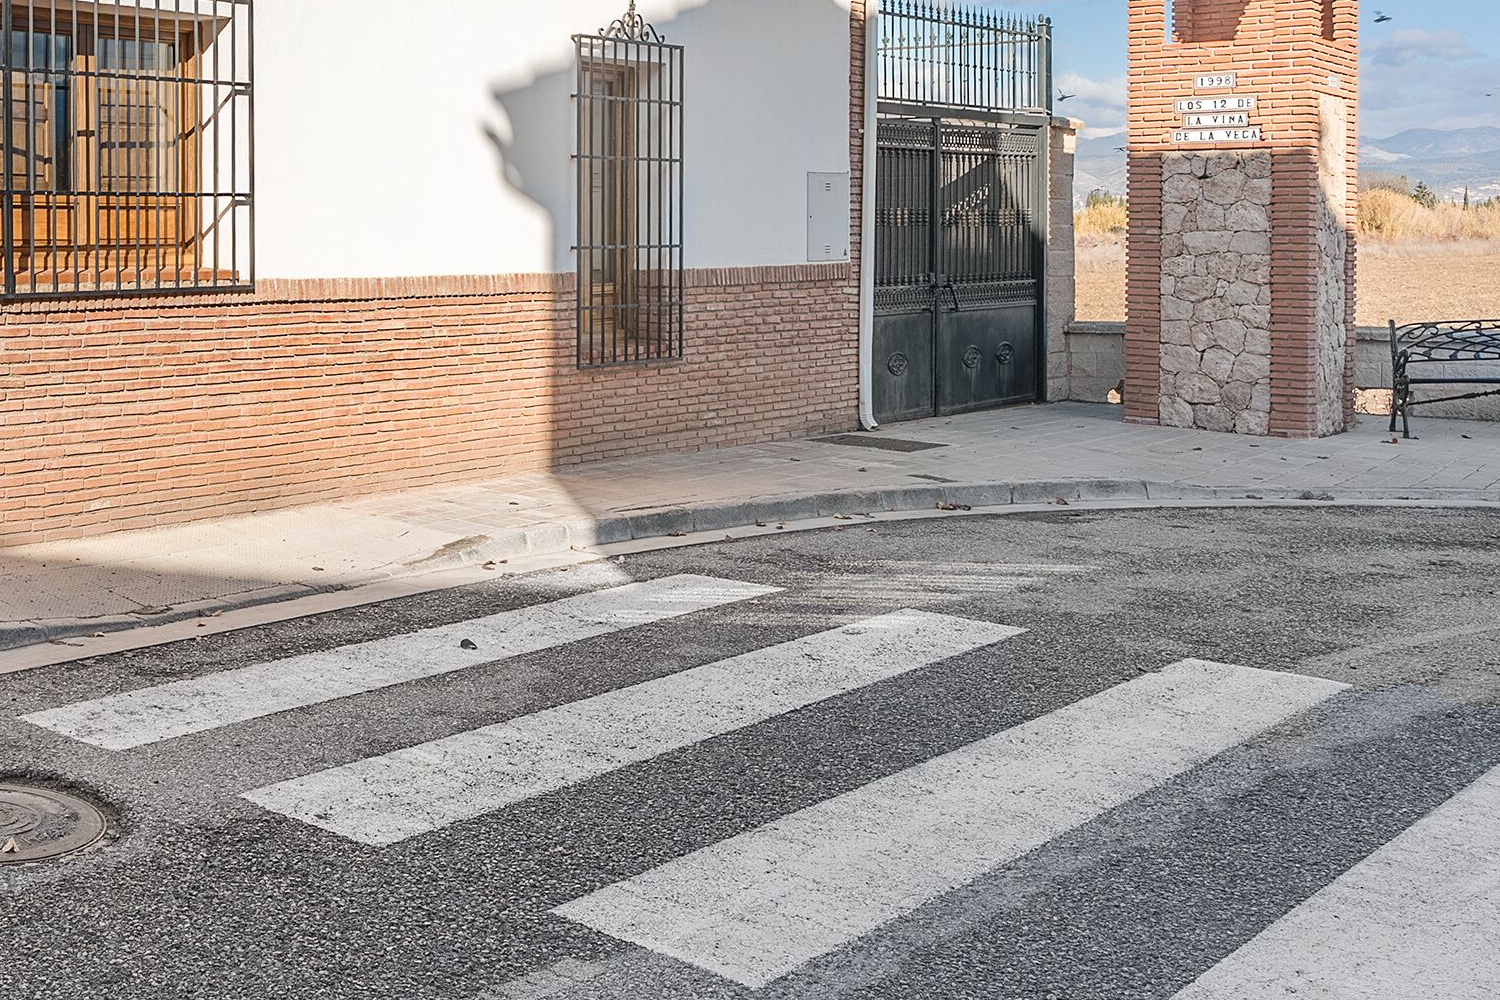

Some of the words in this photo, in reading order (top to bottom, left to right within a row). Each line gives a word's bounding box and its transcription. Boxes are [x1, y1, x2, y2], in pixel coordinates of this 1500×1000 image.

[1200, 76, 1231, 86] 1998
[1179, 101, 1202, 110] LOS
[1213, 99, 1227, 108] 12
[1237, 99, 1253, 108] DE
[1187, 116, 1201, 125] LA
[1175, 132, 1189, 141] DE
[1199, 131, 1214, 140] LA
[1225, 130, 1257, 139] VEGA
